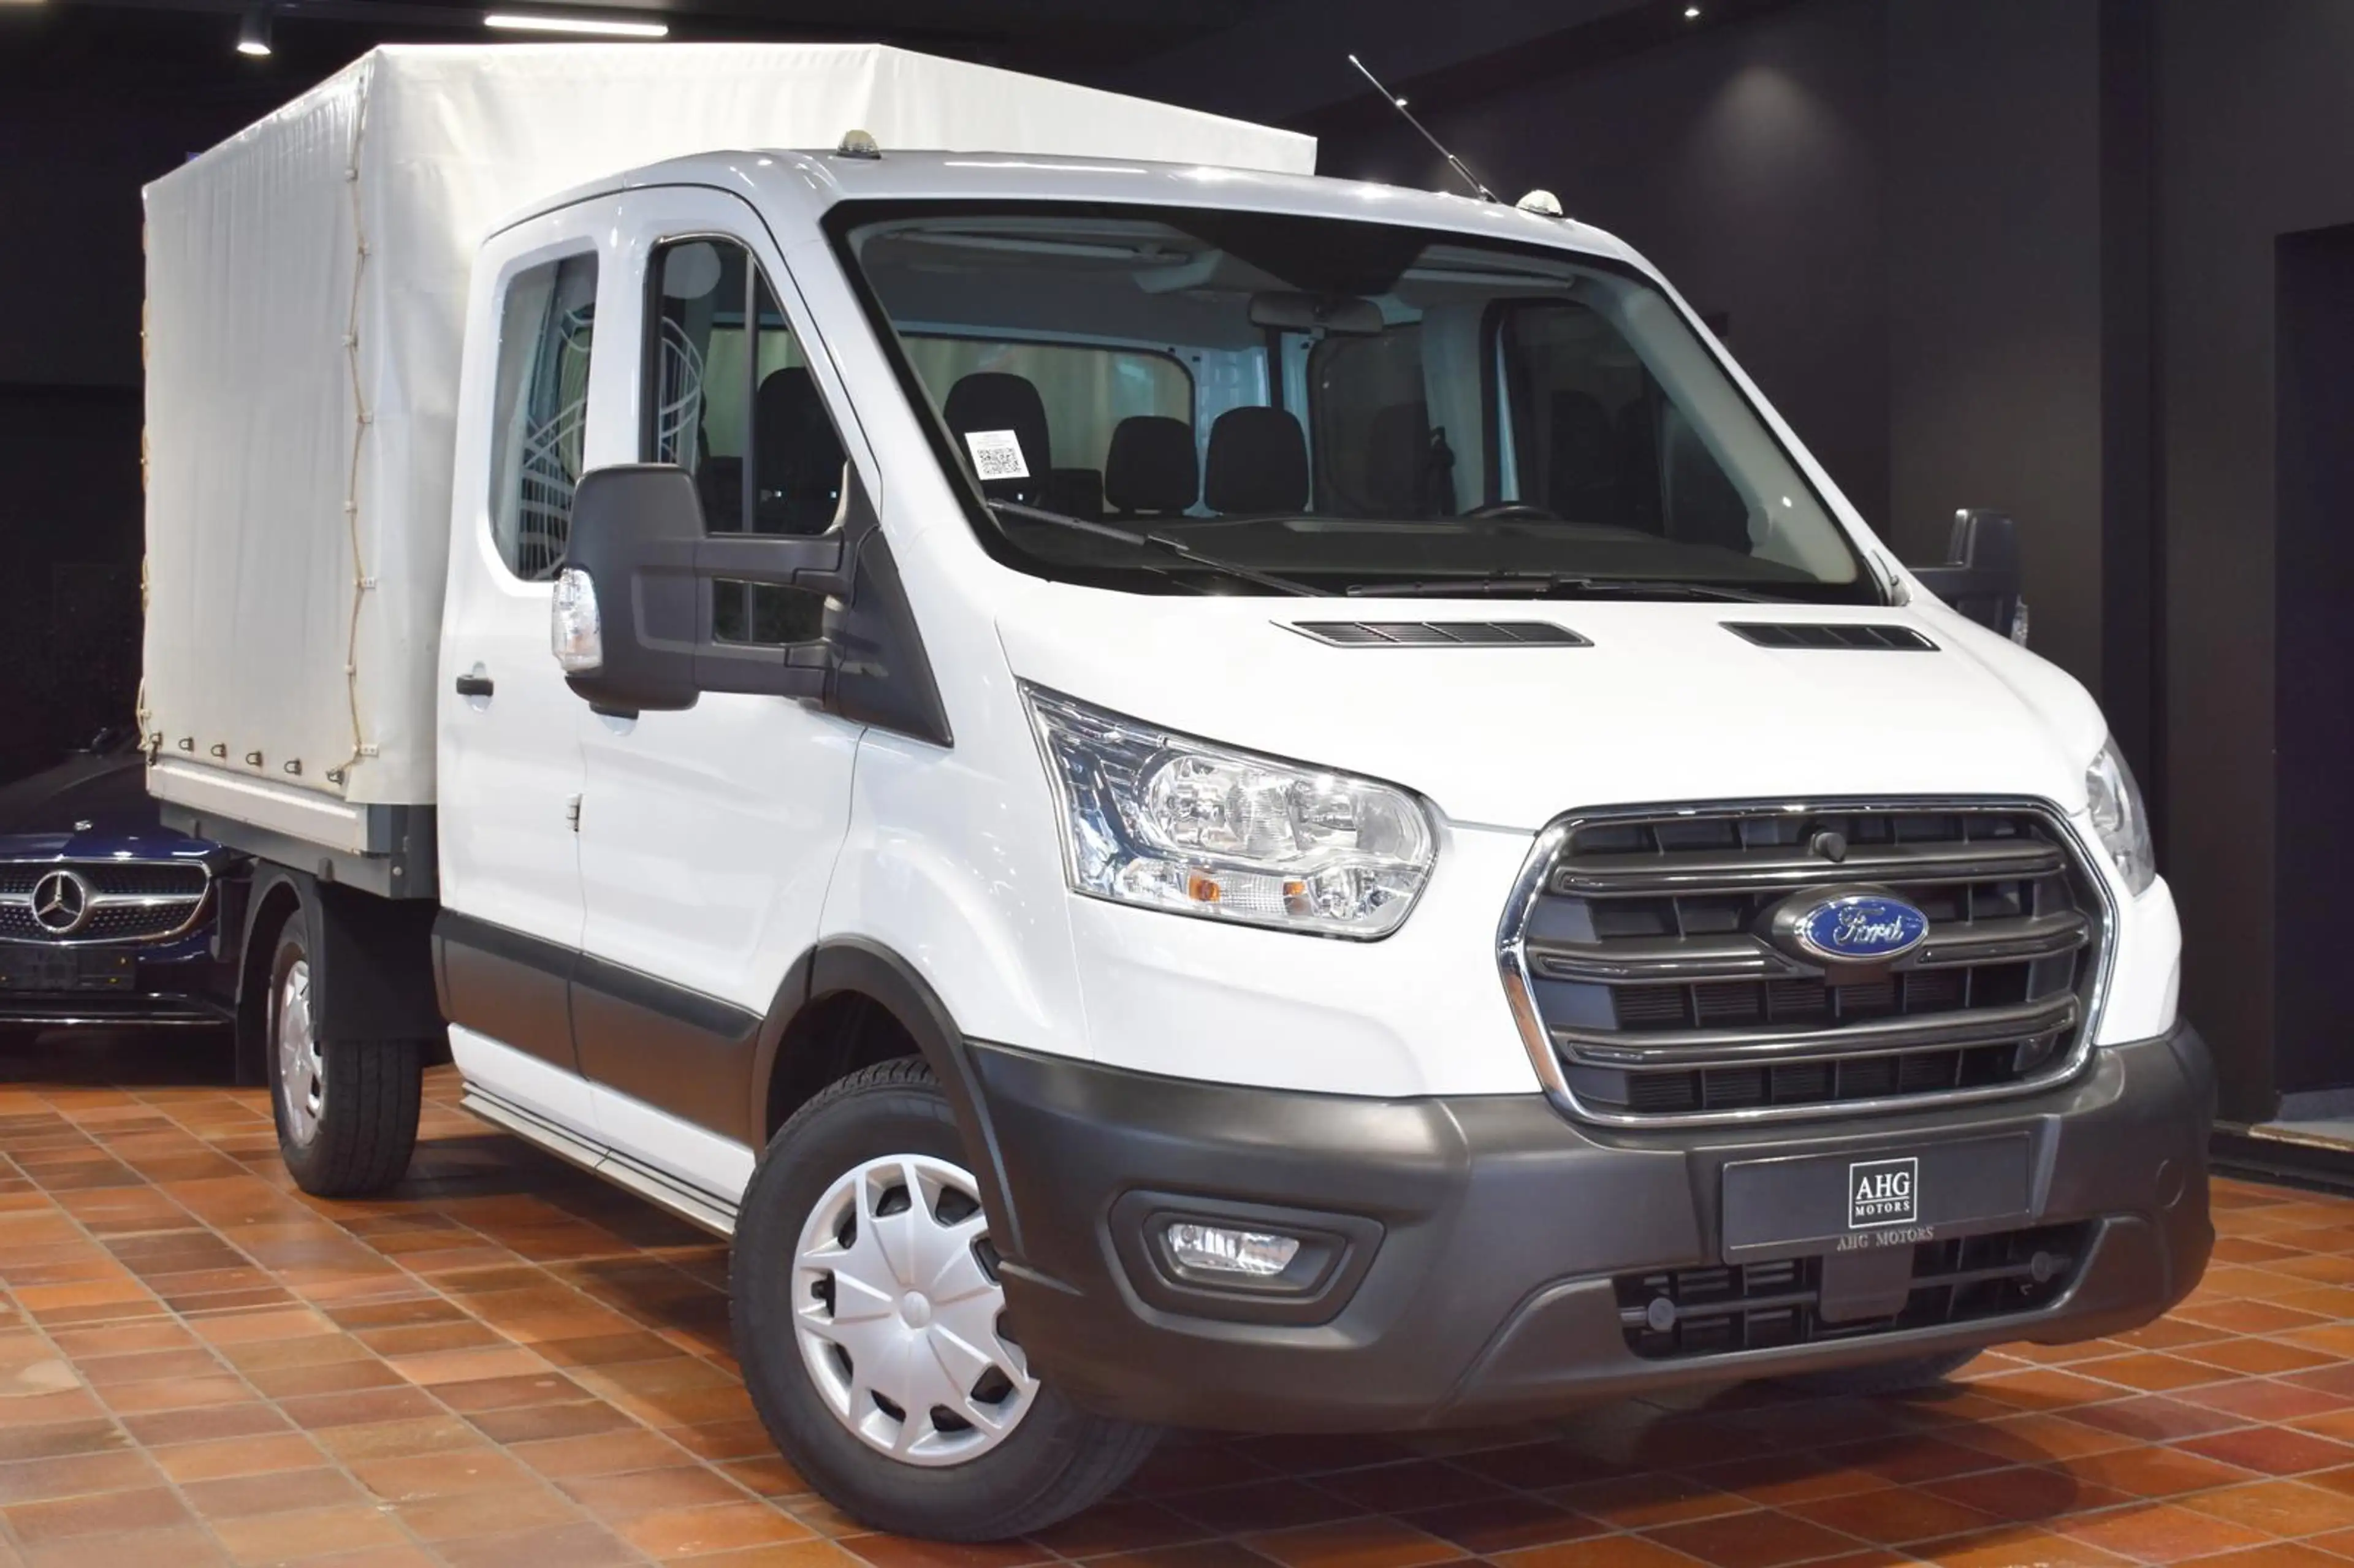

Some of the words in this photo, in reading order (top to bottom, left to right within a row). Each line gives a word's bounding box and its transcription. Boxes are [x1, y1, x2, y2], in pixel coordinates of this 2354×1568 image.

[1833, 906, 1904, 946] Ford
[1856, 1172, 1910, 1200] AHG
[1856, 1201, 1910, 1216] MOTORS
[1838, 1233, 1868, 1251] AHG
[1876, 1227, 1933, 1246] MOTORS
